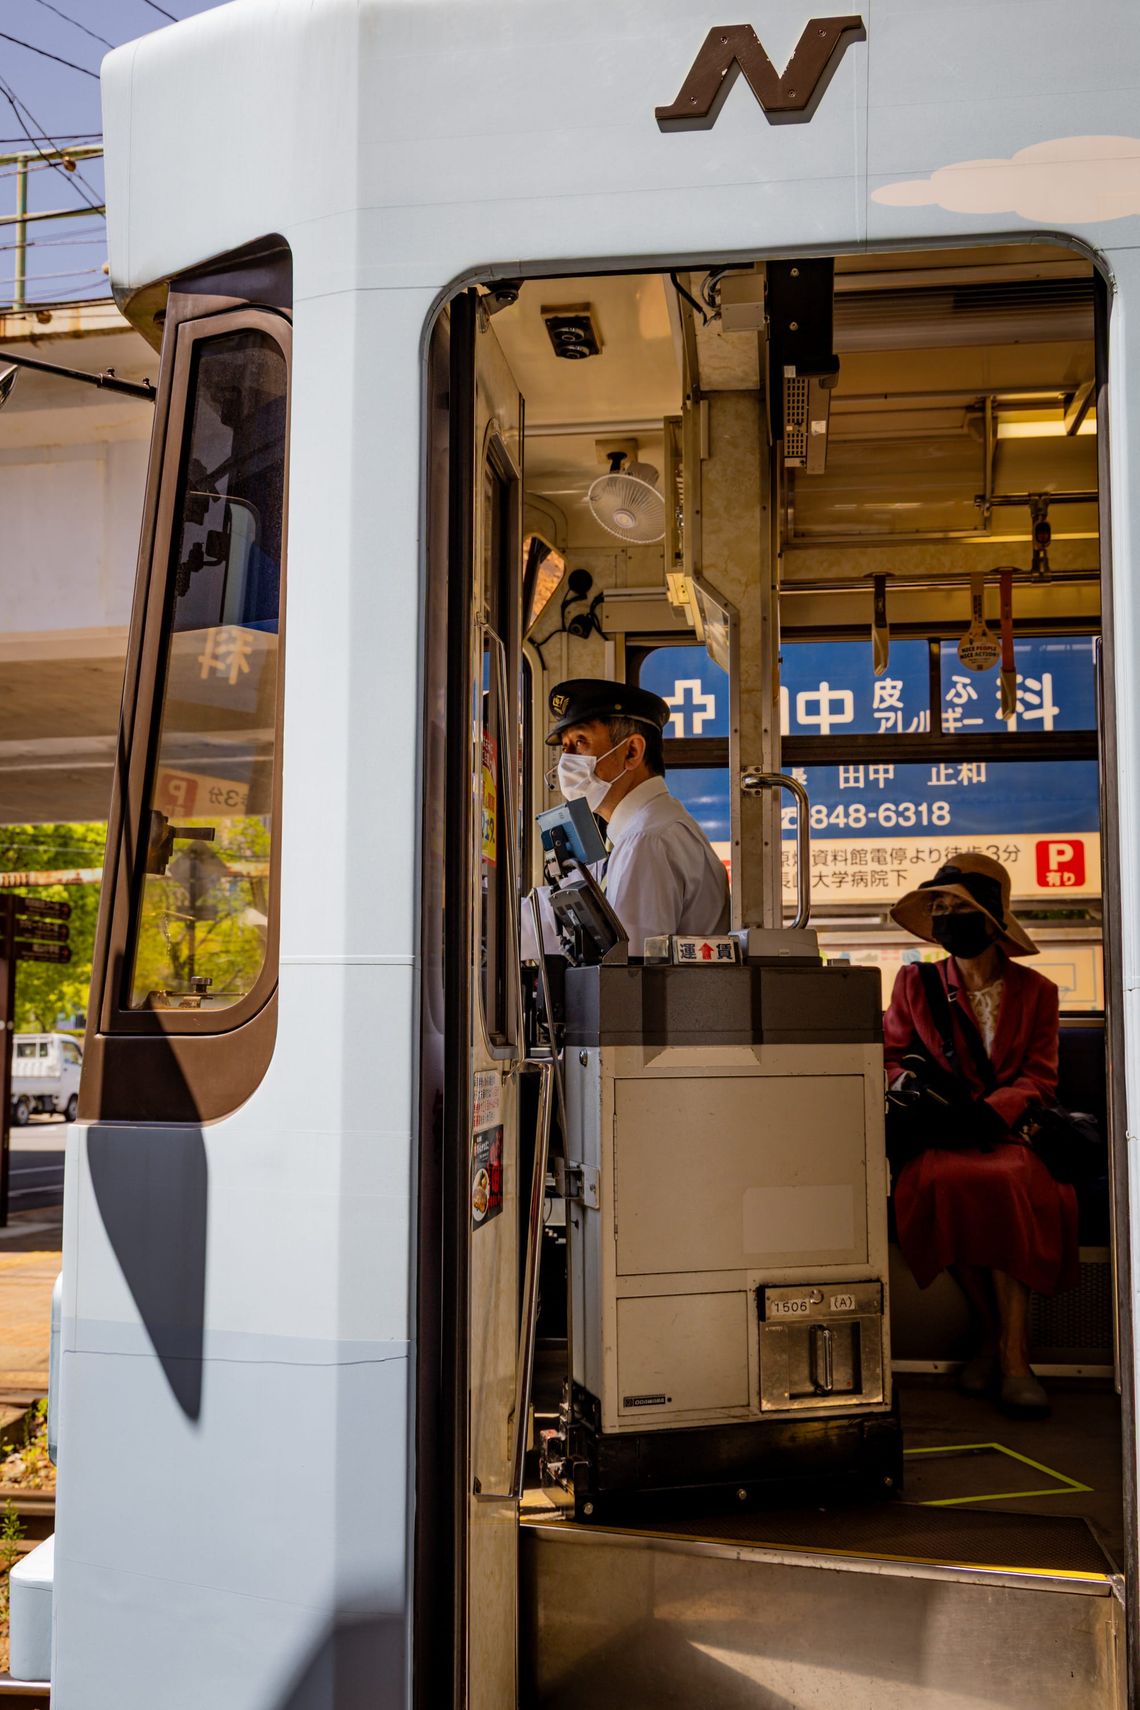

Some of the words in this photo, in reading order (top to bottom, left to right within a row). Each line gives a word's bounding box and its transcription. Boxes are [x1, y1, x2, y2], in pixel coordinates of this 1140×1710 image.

[810, 801, 951, 830] 848-6318
[1048, 843, 1074, 871] P
[774, 1301, 808, 1313] 1506
[834, 1296, 853, 1309] (A)
